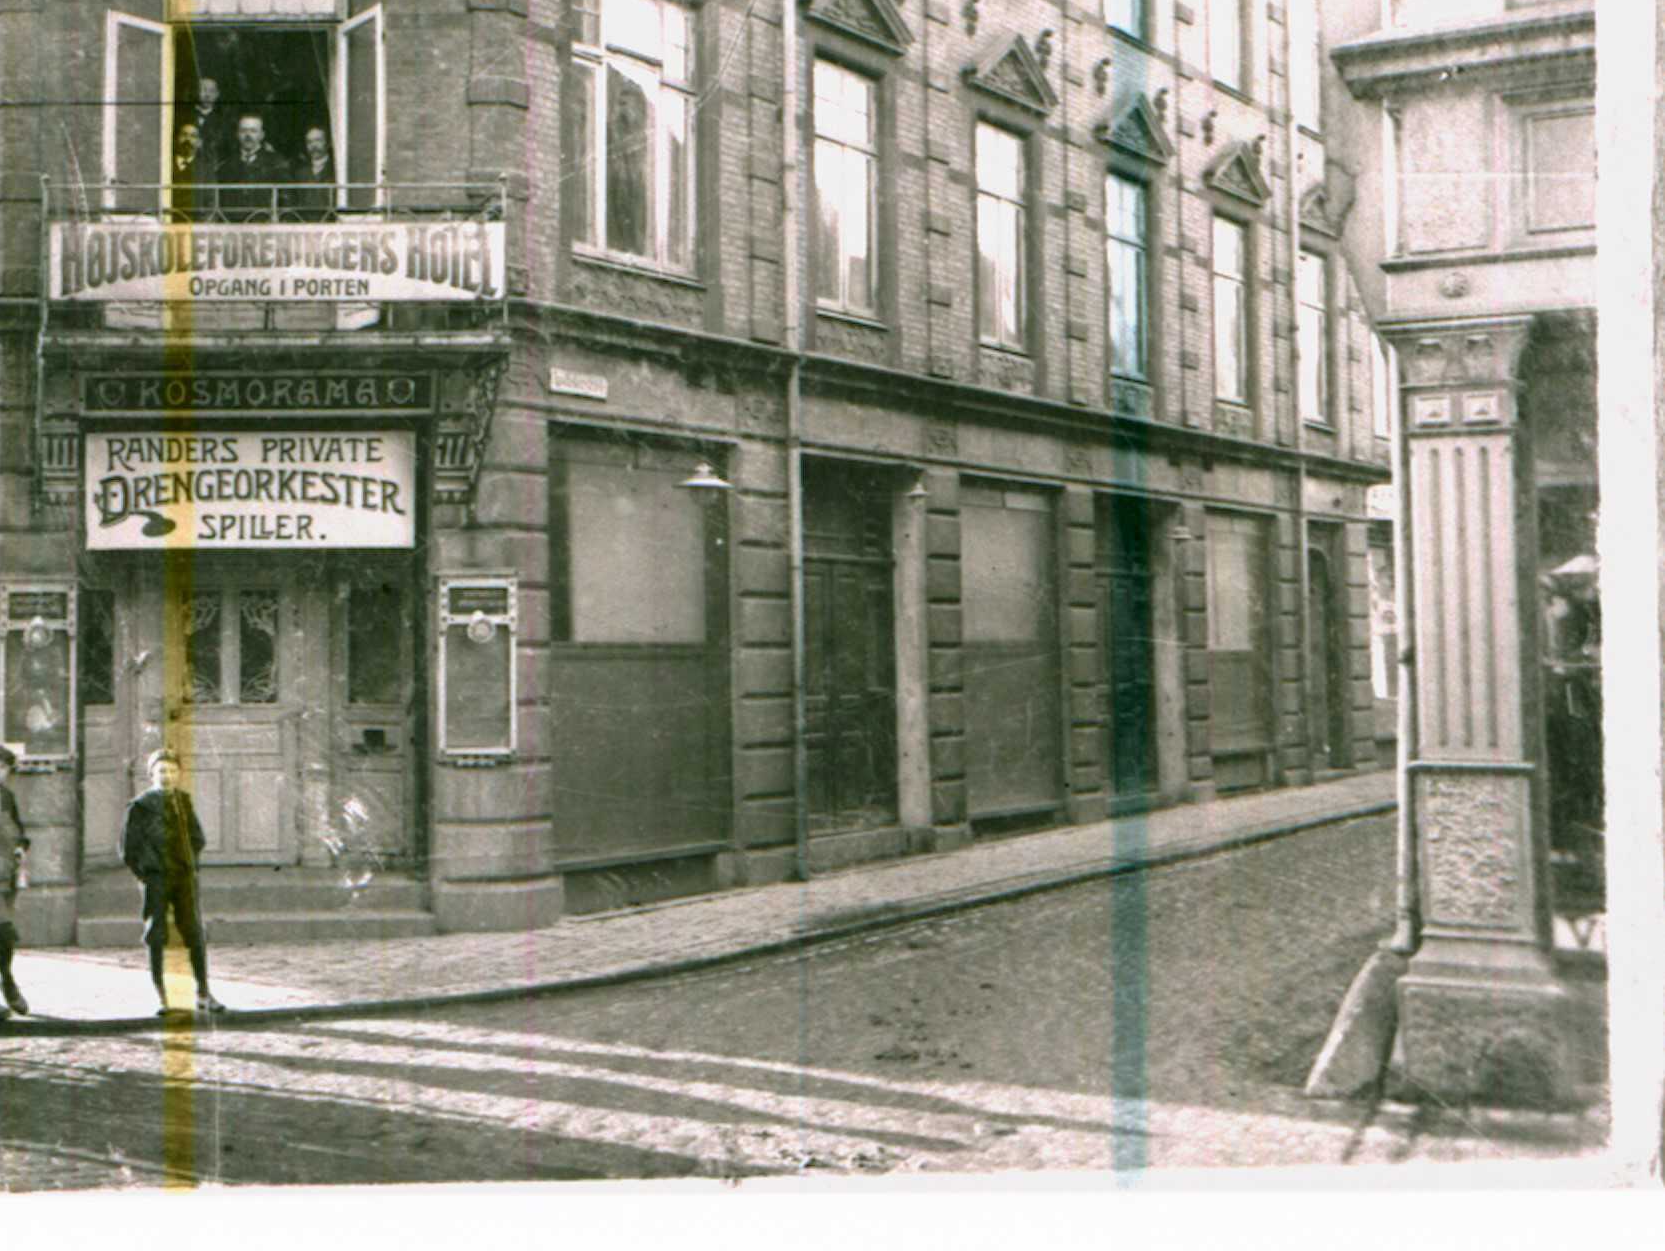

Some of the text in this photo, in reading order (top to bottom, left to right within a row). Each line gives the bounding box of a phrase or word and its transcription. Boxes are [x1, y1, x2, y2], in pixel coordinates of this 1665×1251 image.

[60, 224, 500, 298] HØJSKOLEFORENINGENS HOTEL
[189, 275, 370, 297] OPGANG I PORTEN
[138, 376, 378, 407] KOSMORAMA
[106, 436, 384, 472] RANDERS PRIVATE
[93, 468, 406, 536] DRENGEORKESTER
[197, 513, 327, 542] SPILLER.
